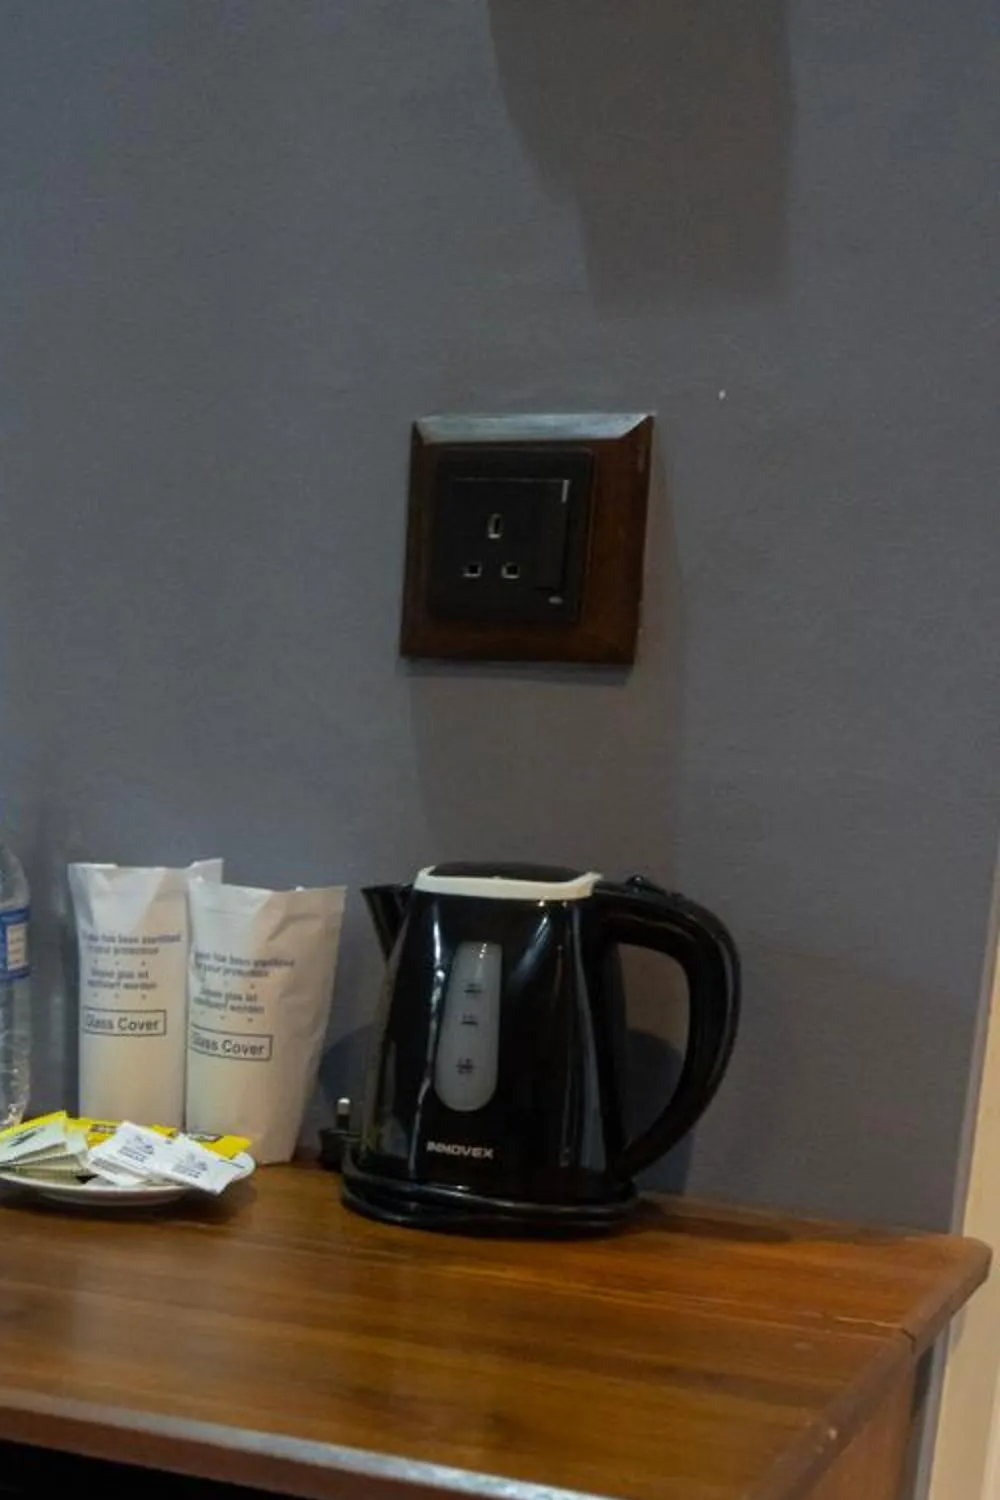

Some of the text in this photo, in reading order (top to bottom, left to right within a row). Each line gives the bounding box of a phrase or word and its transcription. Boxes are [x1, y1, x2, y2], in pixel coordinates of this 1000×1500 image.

[117, 1017, 160, 1031] Cover
[221, 1039, 265, 1056] Cover
[426, 1141, 494, 1159] INNOVEX
